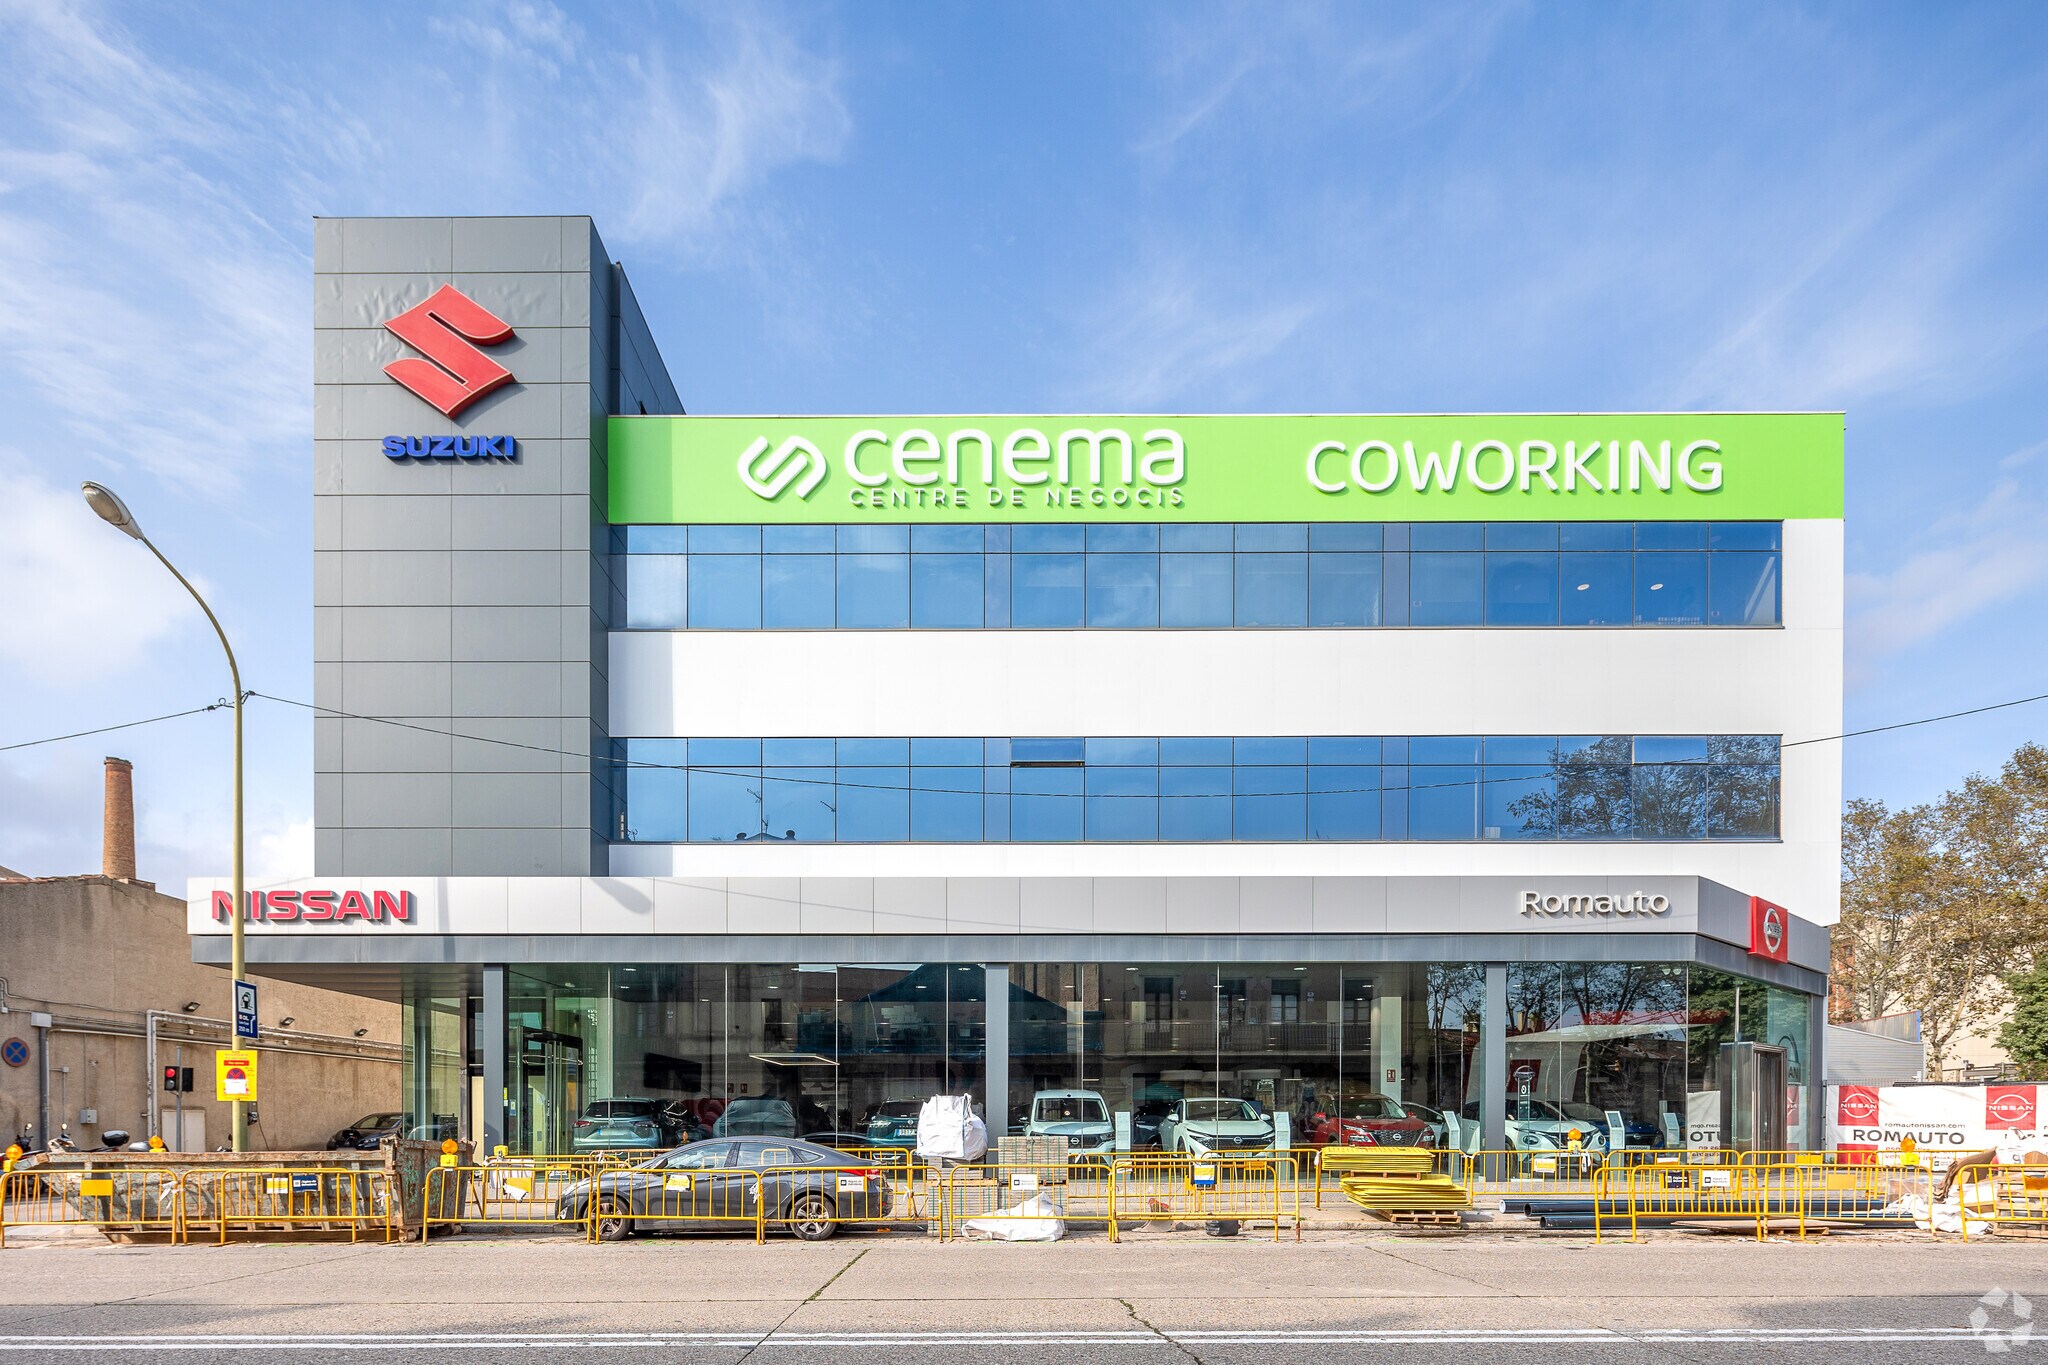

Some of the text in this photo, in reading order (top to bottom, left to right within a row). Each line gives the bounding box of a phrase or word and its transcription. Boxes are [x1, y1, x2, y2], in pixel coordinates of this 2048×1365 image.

[382, 435, 516, 458] SUZUKI
[844, 428, 1186, 487] cenema
[1306, 439, 1724, 493] COWORKING
[849, 487, 1185, 507] CENTRE DE NEGOCIS
[211, 890, 409, 920] NISSAN
[1520, 890, 1670, 915] Romauto
[1840, 1102, 1877, 1110] NISSAN
[1853, 1129, 1965, 1145] ROMAUTO
